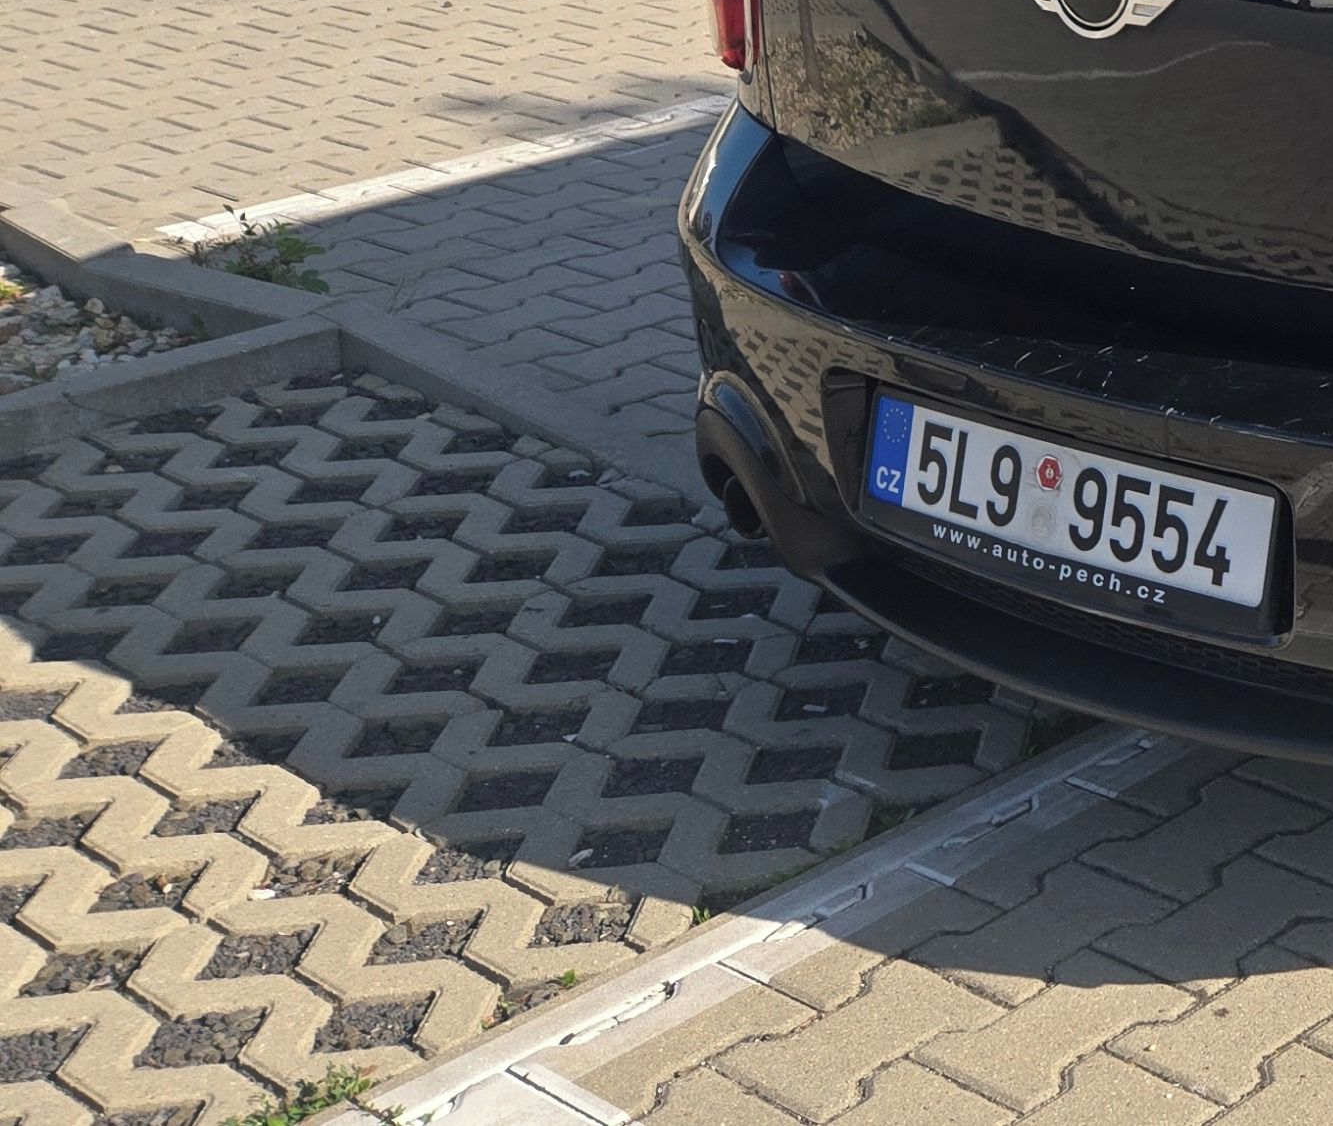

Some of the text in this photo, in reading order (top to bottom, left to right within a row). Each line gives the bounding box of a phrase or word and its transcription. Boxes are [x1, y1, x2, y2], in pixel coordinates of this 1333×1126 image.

[875, 465, 901, 494] CZ
[917, 421, 1231, 587] 5L9 9554
[933, 522, 1166, 604] www.auto-pech.cz
